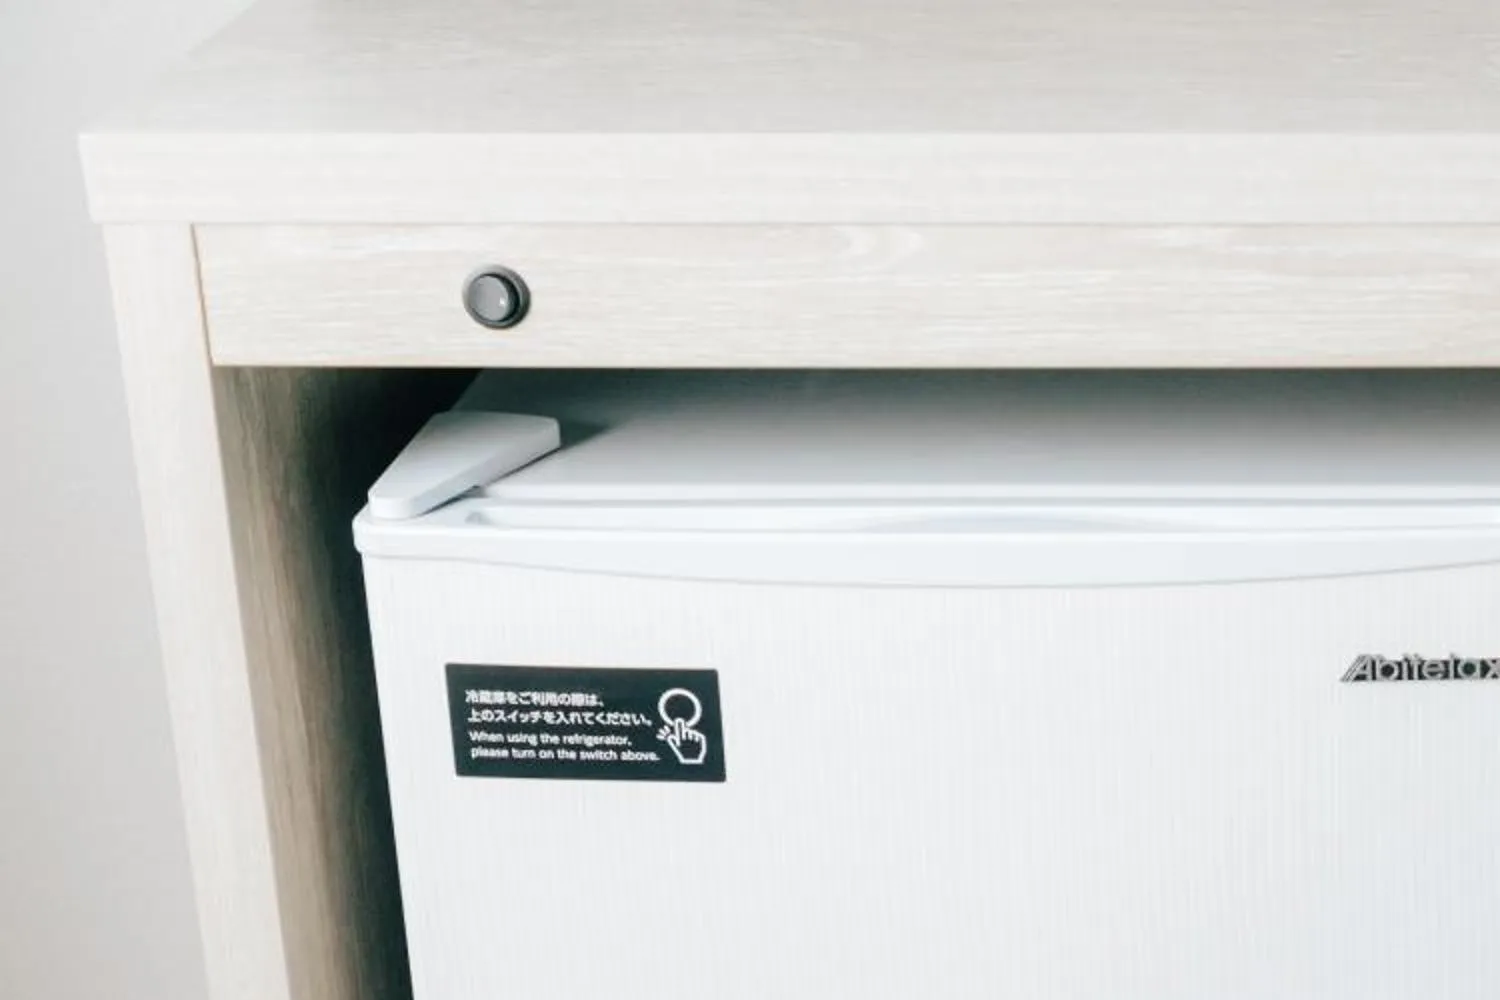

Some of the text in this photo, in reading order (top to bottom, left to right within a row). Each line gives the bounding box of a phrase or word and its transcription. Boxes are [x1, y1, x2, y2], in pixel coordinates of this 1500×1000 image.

[468, 709, 653, 726] 上のスイッチを入れてください。
[469, 731, 505, 743] When
[507, 732, 537, 746] using
[540, 732, 561, 745] the
[471, 746, 661, 762] please turn on the switch above.
